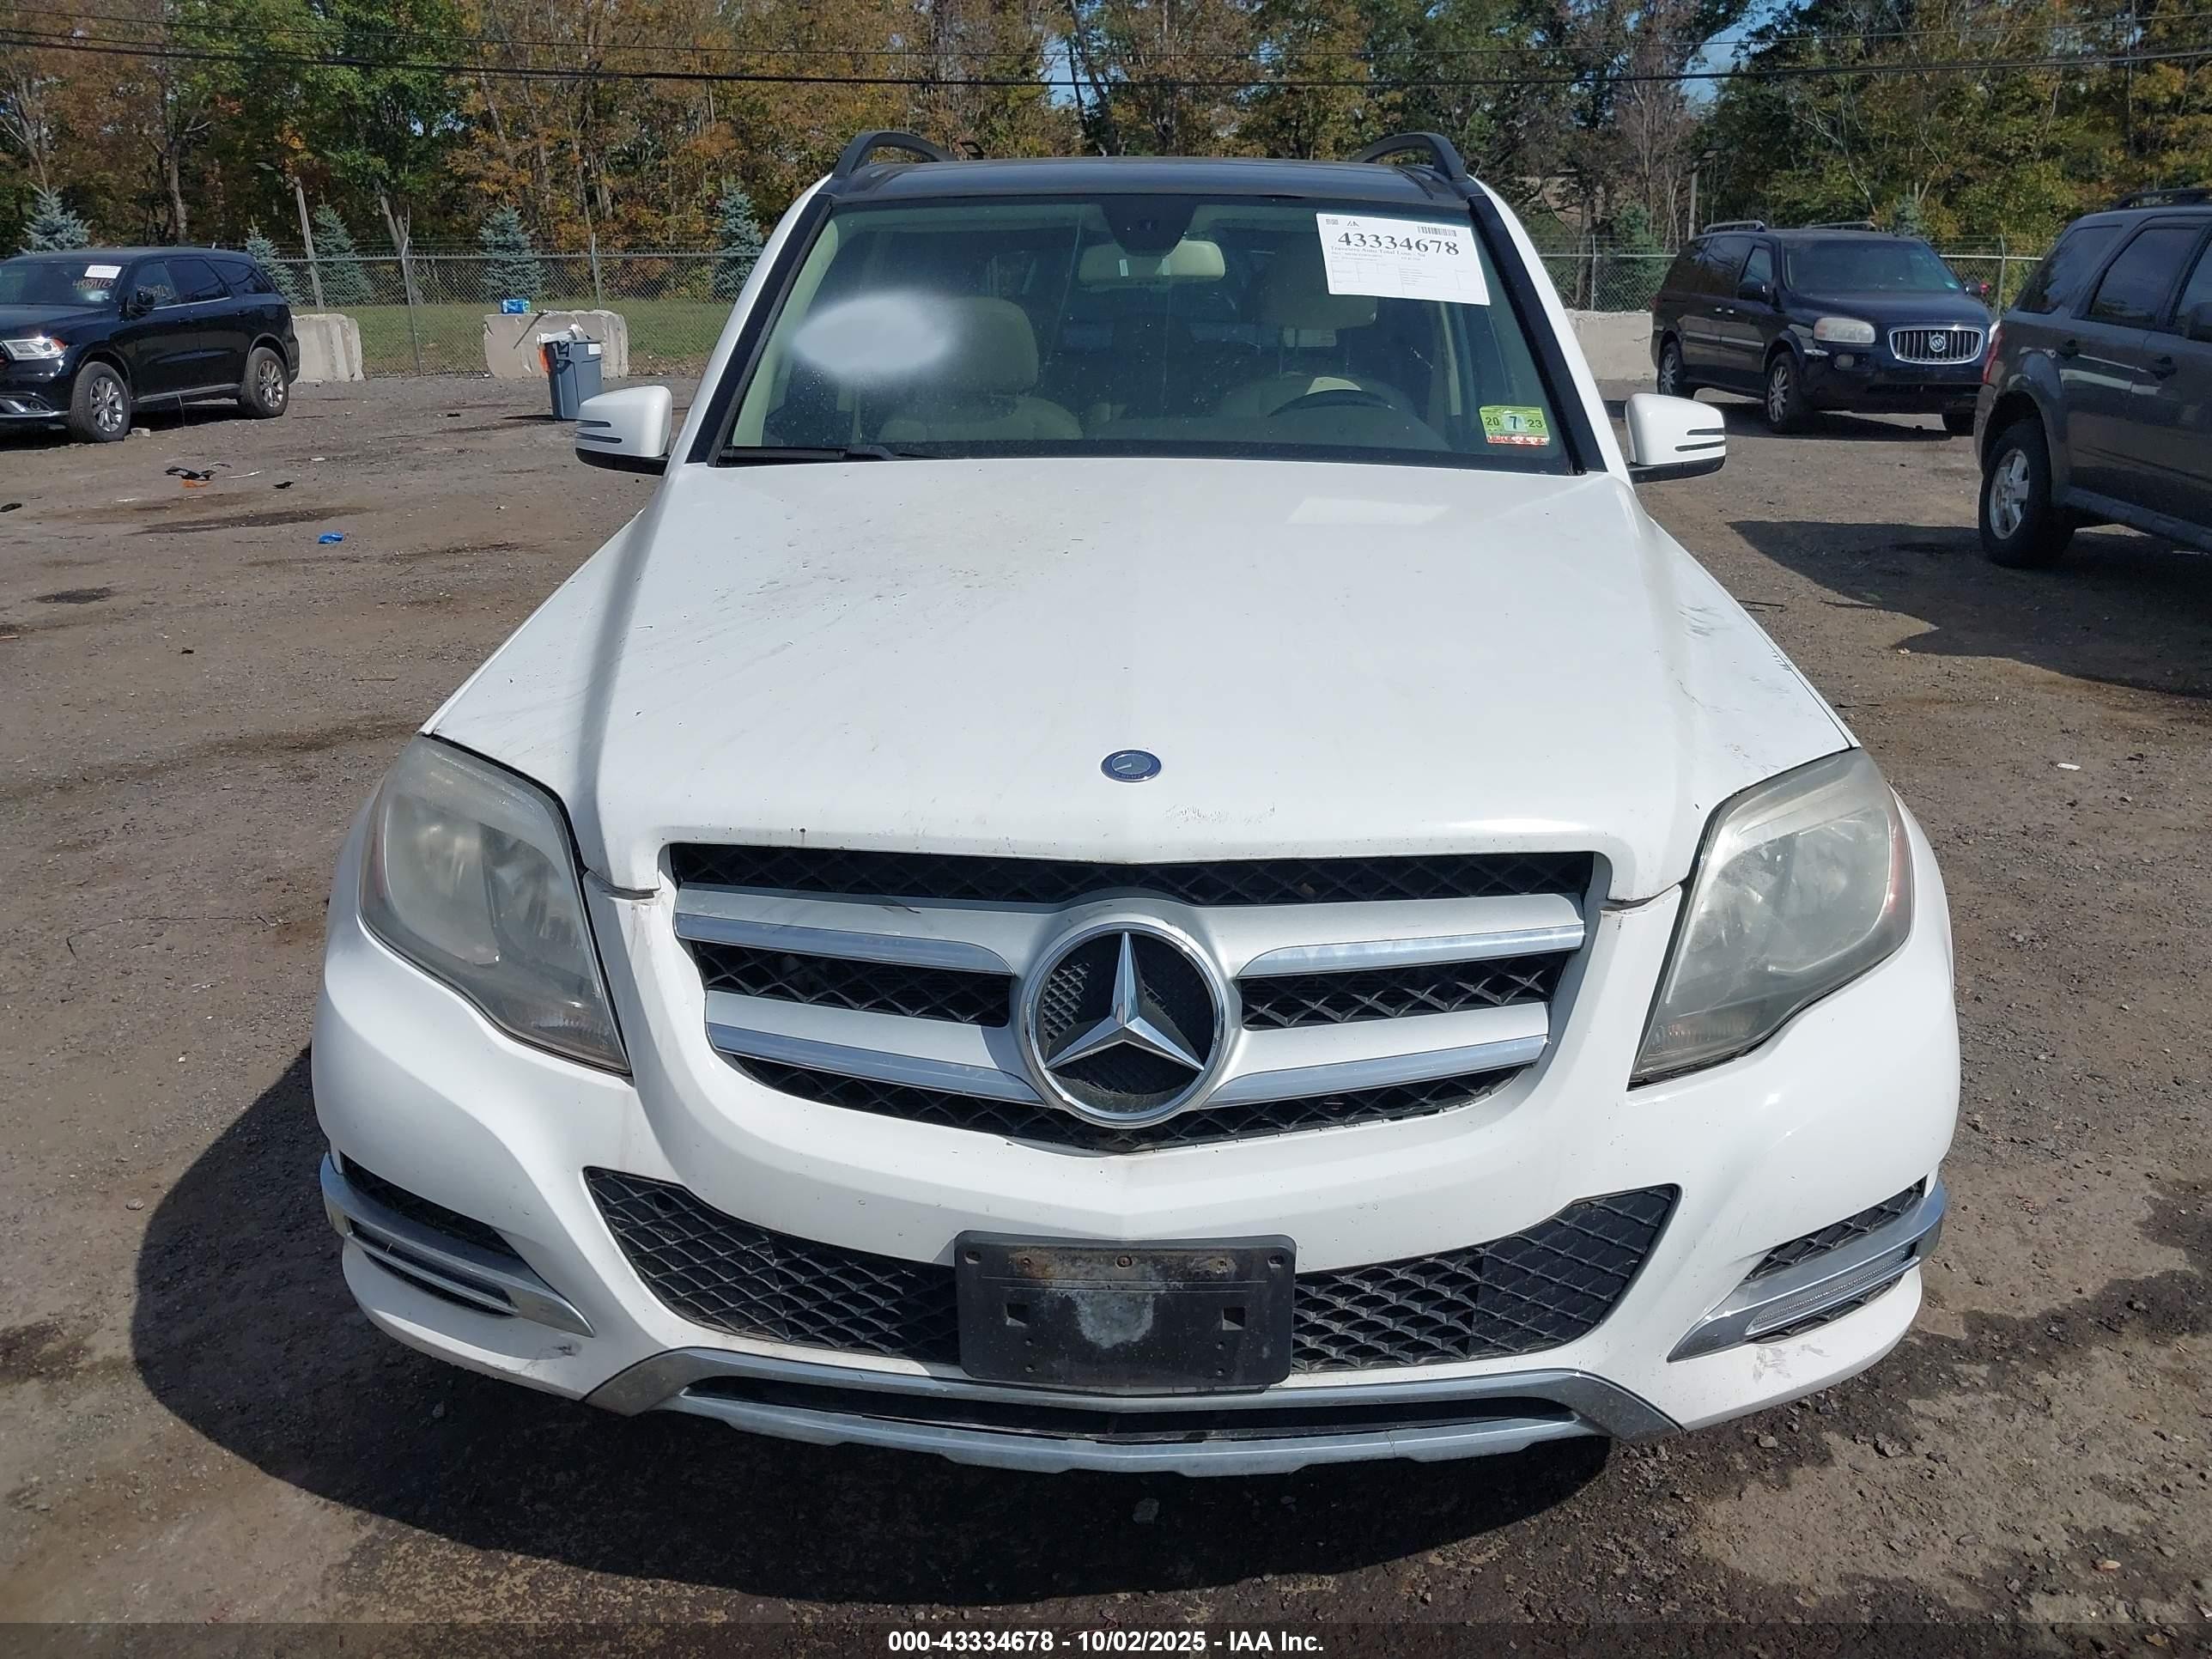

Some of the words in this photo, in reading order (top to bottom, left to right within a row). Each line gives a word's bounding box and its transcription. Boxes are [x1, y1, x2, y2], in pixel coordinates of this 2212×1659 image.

[1338, 232, 1460, 256] 43334678
[1486, 416, 1499, 427] 20
[1510, 416, 1517, 429] 7
[1528, 419, 1543, 428] 23
